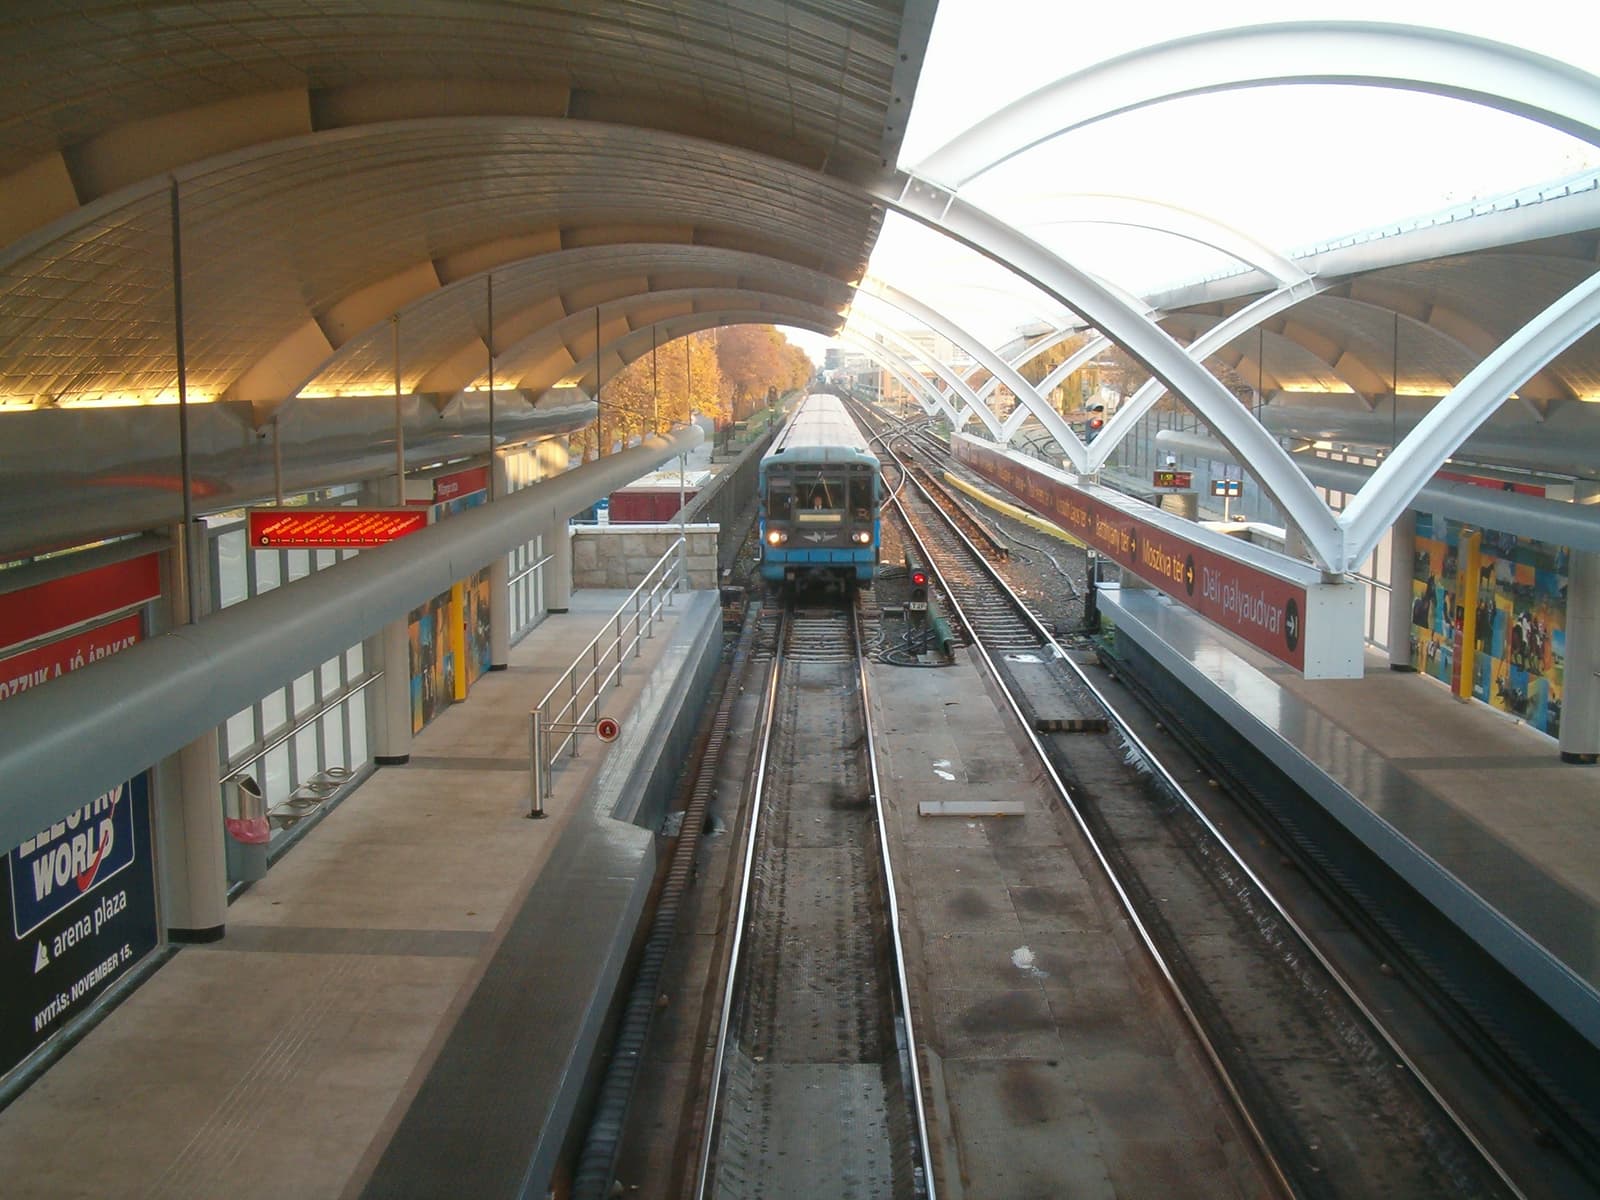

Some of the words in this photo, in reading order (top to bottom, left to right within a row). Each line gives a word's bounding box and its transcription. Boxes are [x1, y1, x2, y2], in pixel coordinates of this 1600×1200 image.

[1142, 537, 1171, 577] Moszkva
[1173, 553, 1185, 583] tér
[1203, 567, 1221, 604] Déli
[1223, 577, 1282, 634] pályaudvar
[33, 818, 114, 902] WORLD
[54, 915, 92, 957] arena
[94, 890, 127, 935] plaza
[34, 994, 70, 1032] NYITÁS:
[71, 952, 119, 1001] NOVEMBER
[120, 943, 133, 963] 15.
